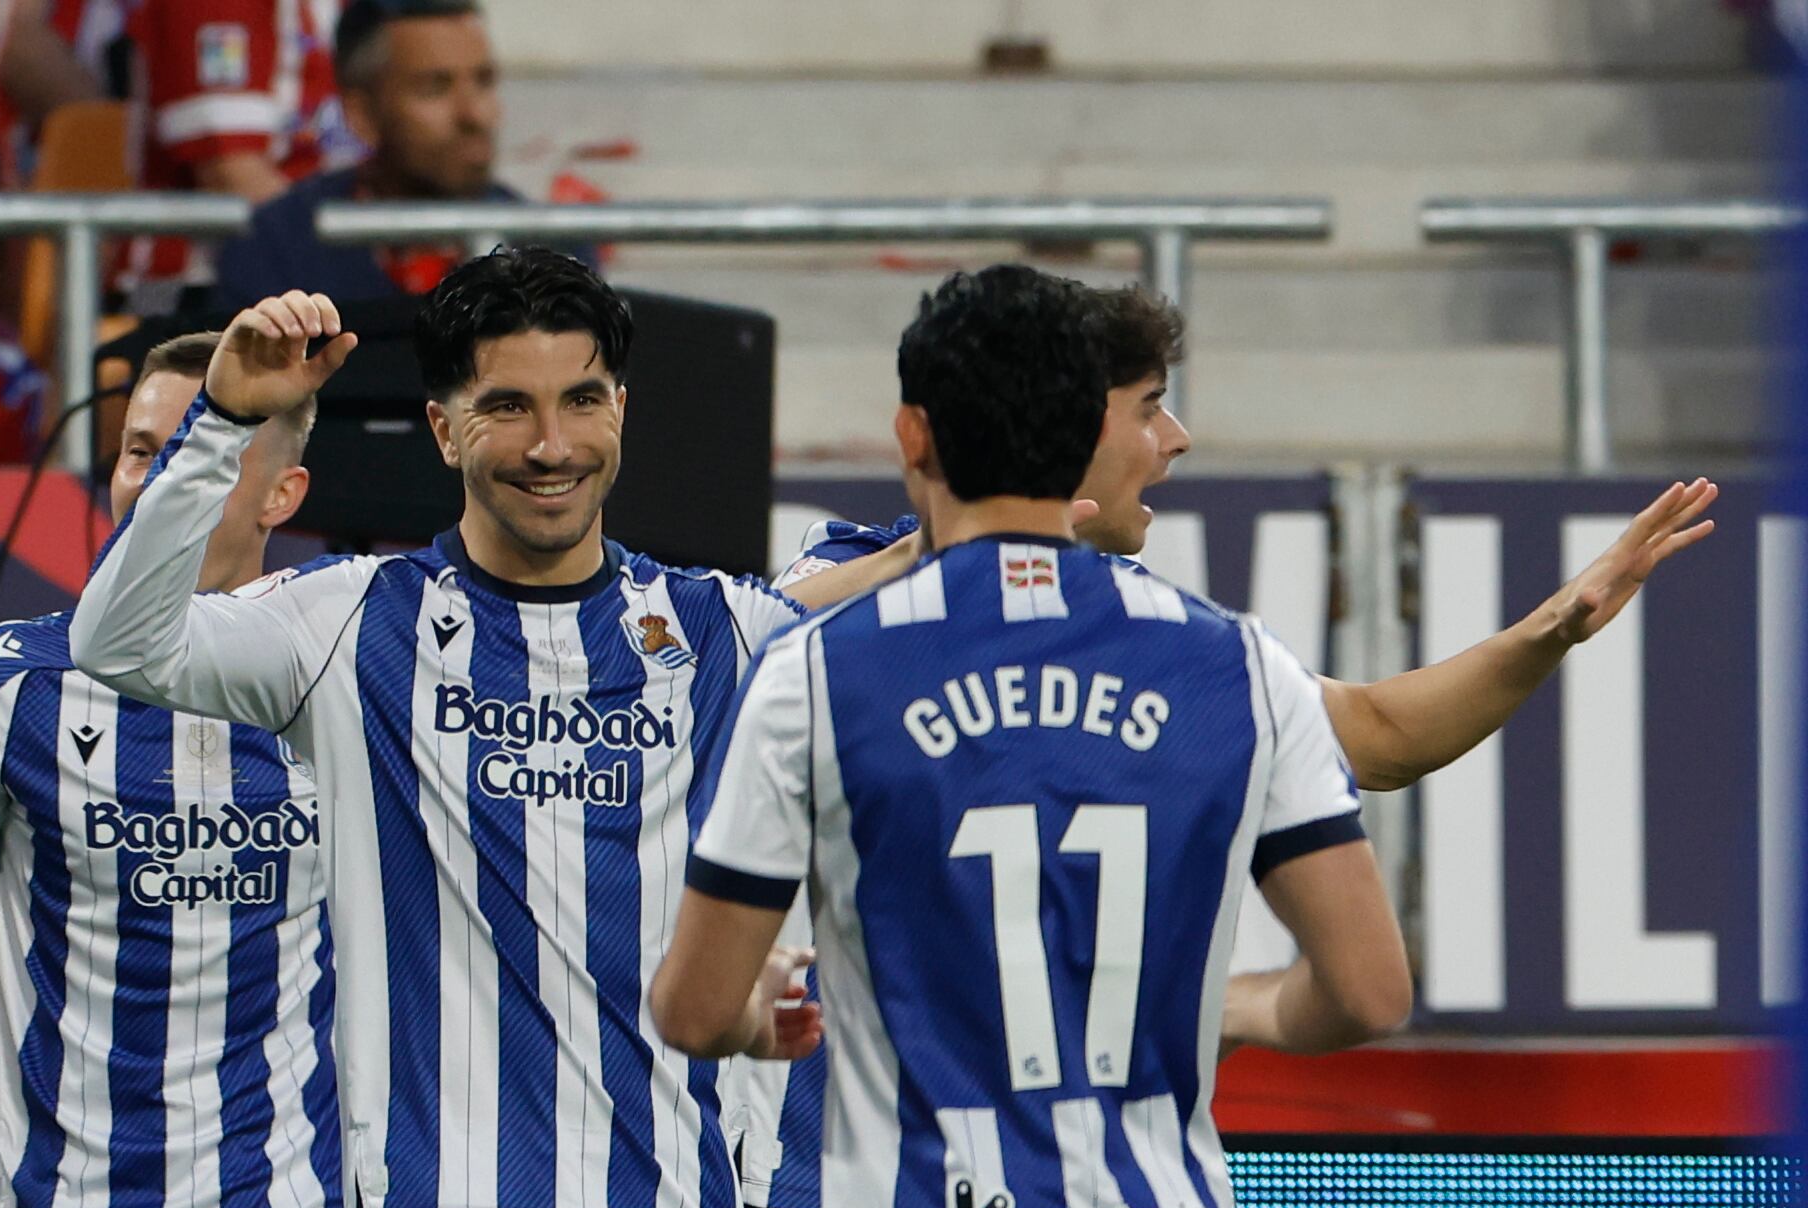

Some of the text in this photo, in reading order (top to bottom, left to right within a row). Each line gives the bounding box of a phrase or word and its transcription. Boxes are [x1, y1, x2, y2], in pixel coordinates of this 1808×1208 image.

[434, 682, 677, 751] Baghdadi
[902, 664, 1172, 759] GUEDES
[479, 752, 626, 808] Capital
[82, 800, 321, 861] Baghdadi
[132, 865, 273, 911] Capital
[947, 803, 1149, 1094] 11
